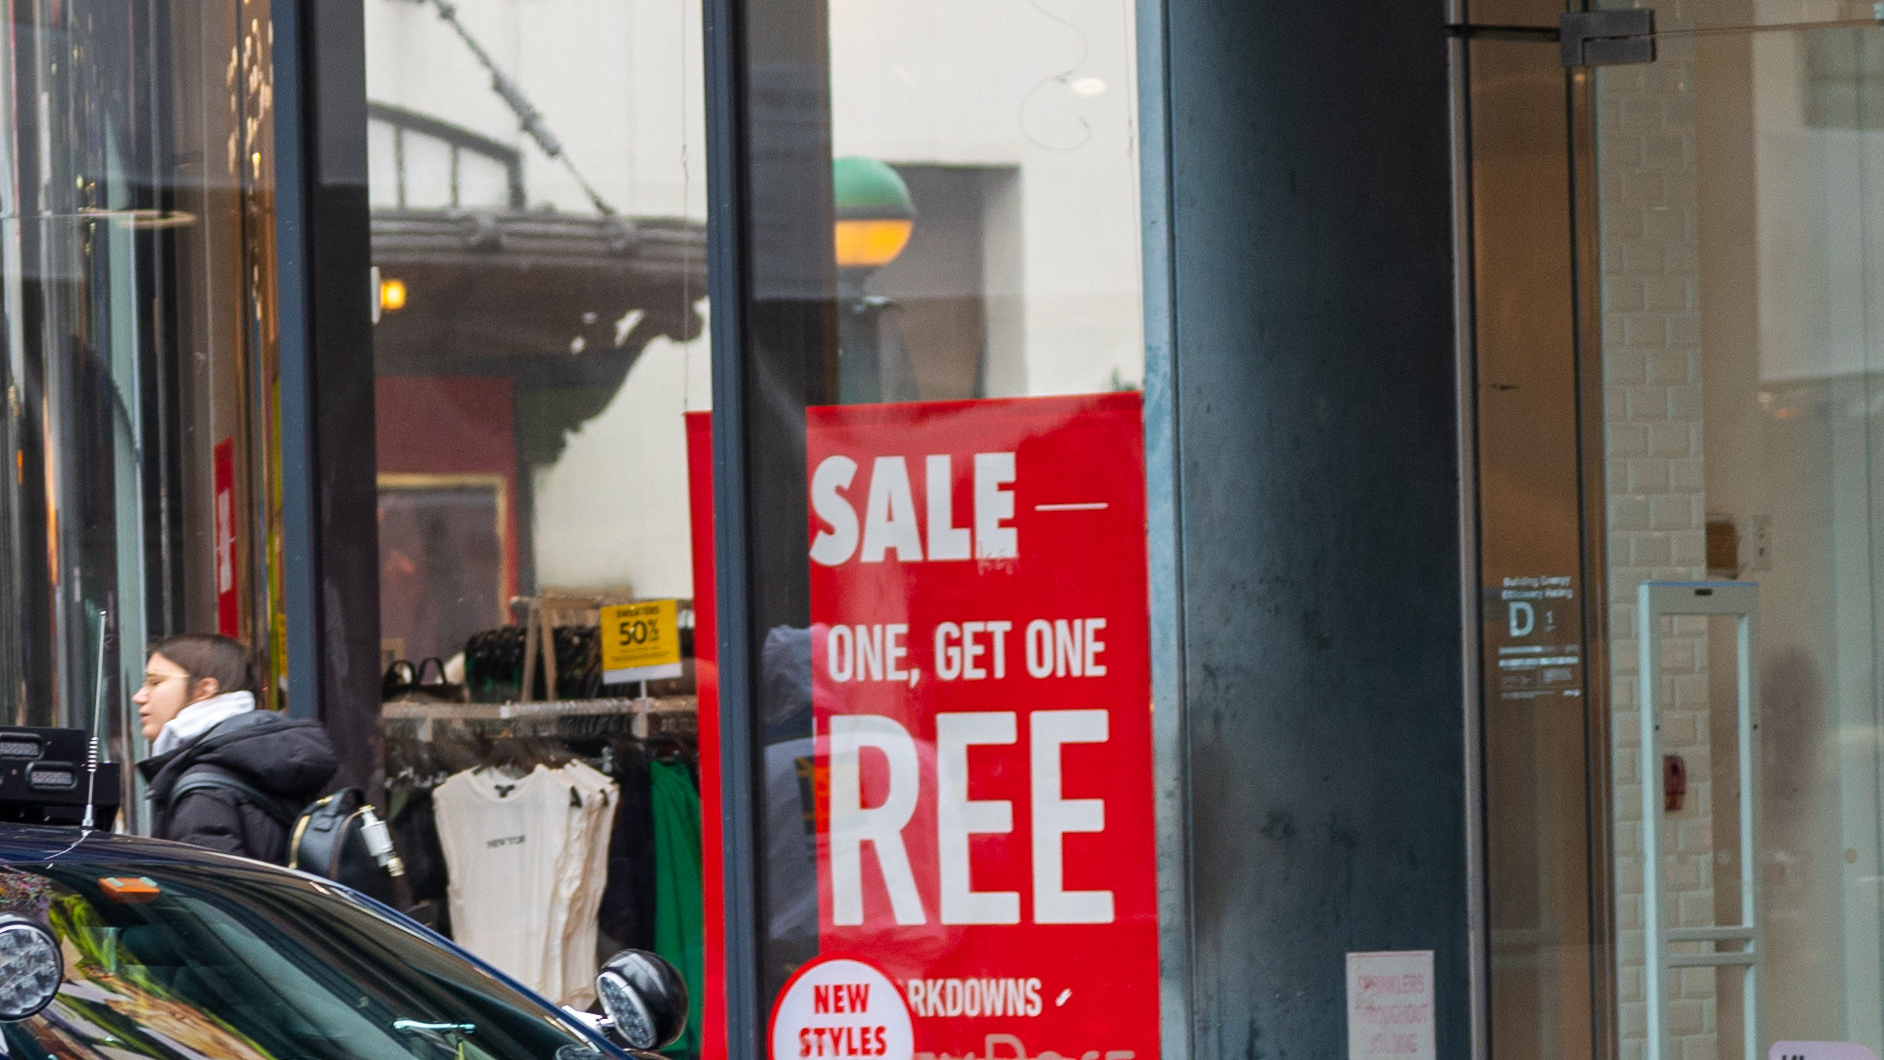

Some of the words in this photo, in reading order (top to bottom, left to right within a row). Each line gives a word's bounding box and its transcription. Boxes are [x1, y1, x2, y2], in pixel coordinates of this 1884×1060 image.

[808, 452, 1018, 566] SALE
[1509, 601, 1535, 637] D
[827, 623, 920, 688] ONE,
[934, 620, 1012, 680] GET
[1025, 617, 1107, 679] ONE
[829, 708, 1115, 927] REE
[812, 982, 871, 1015] NEW
[905, 977, 1043, 1018] RKDOWNS
[798, 1025, 888, 1058] STYLES
